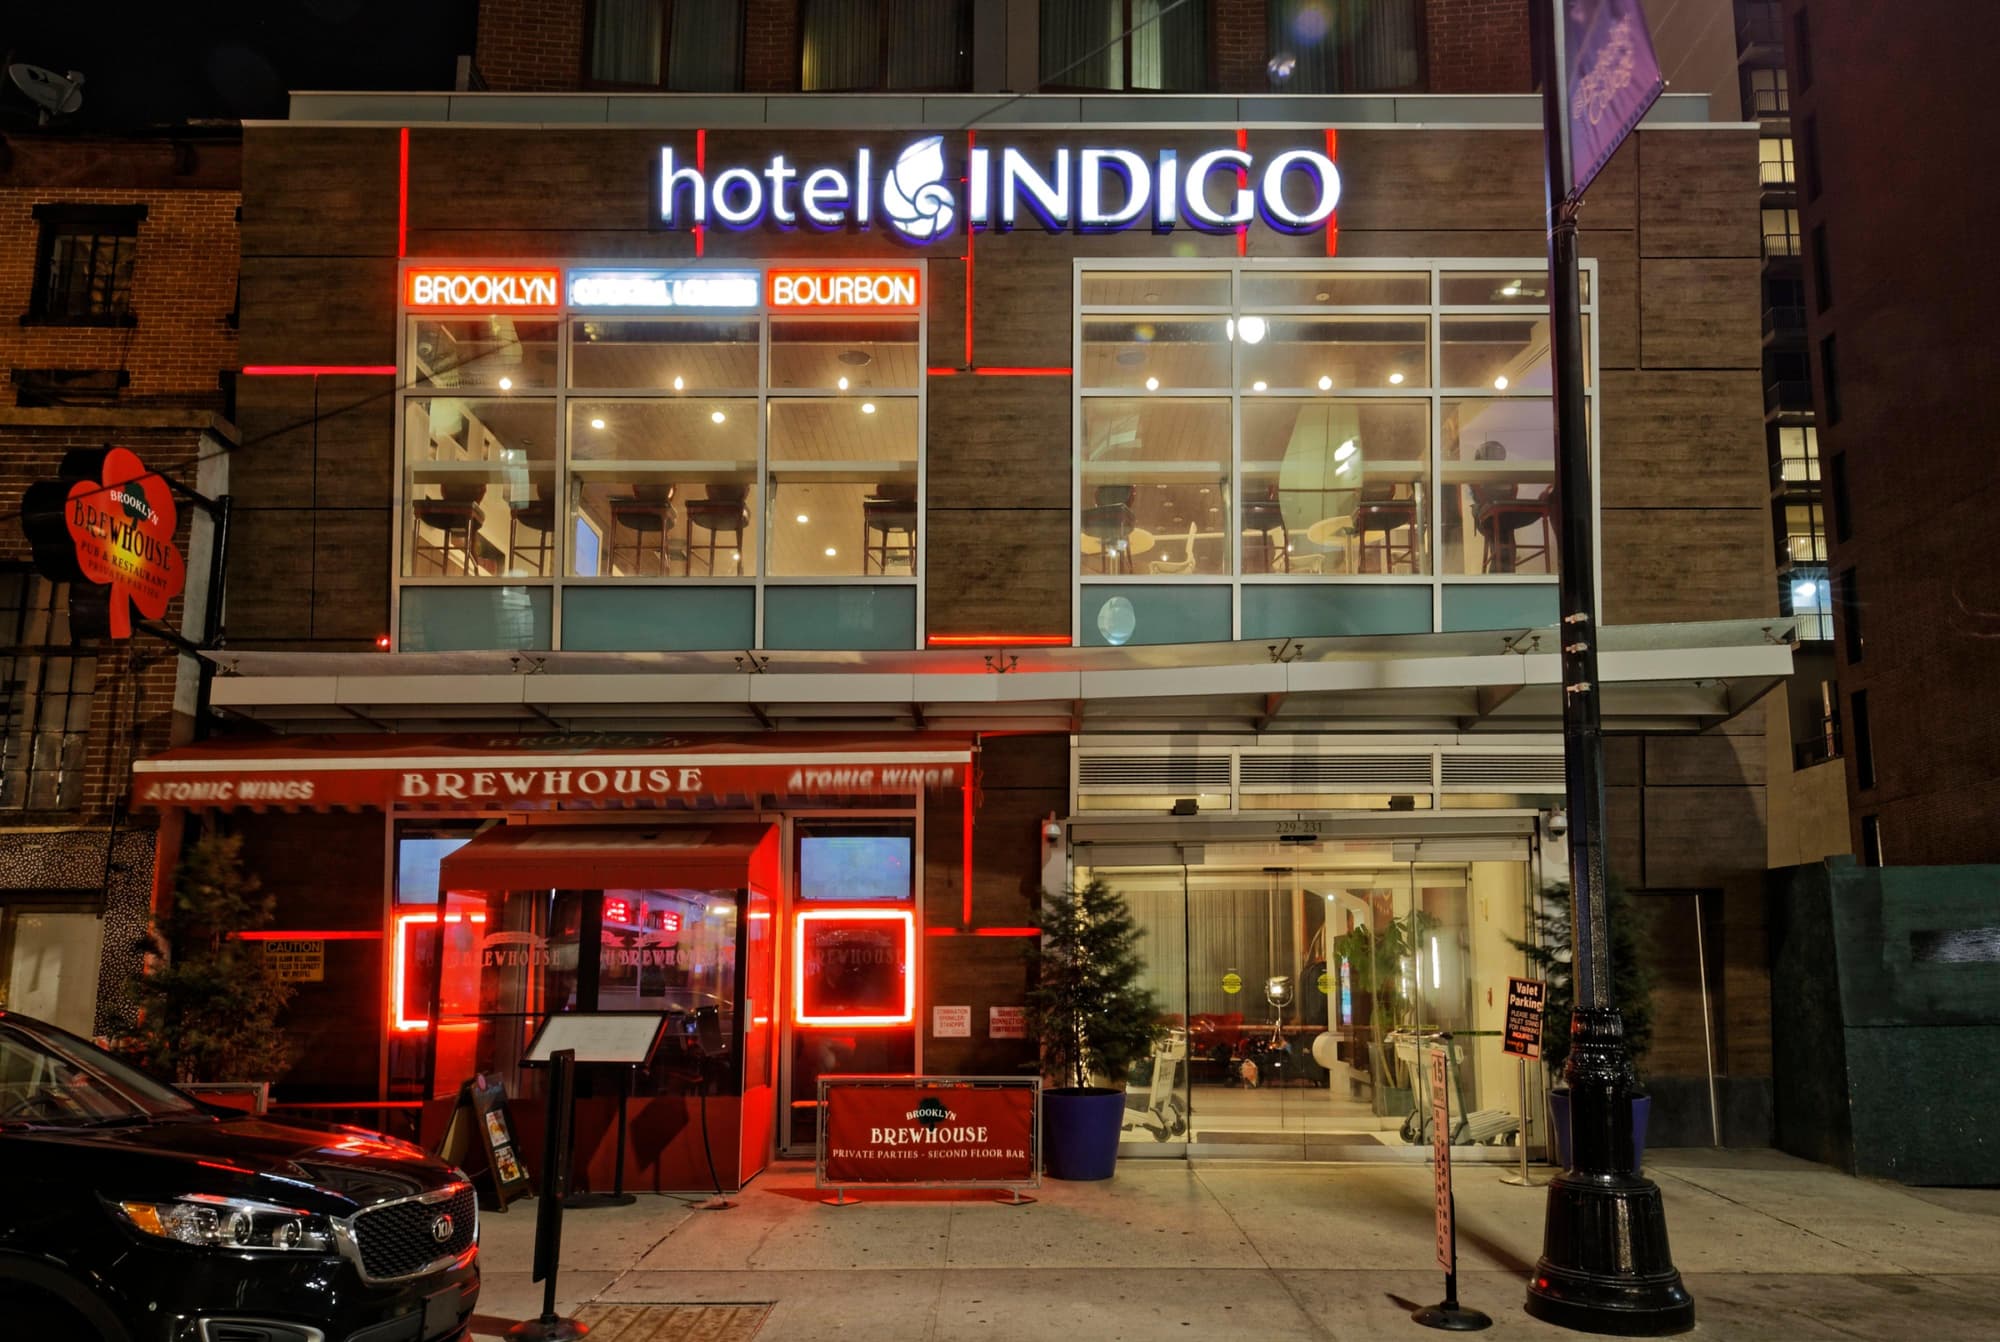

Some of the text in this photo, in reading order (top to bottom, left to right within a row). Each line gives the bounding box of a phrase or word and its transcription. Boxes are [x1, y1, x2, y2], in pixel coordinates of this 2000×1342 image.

[661, 146, 1341, 225] hotel INDIGO
[414, 275, 557, 305] BROOKLYN
[774, 275, 915, 305] BOURBON
[110, 489, 159, 526] BROOKLYN
[73, 500, 171, 571] BREWHOUSE
[81, 541, 99, 557] PUB
[112, 554, 168, 589] RESTAURANT
[401, 768, 703, 799] BREWHOUSE
[788, 769, 874, 790] ATOMIC
[145, 782, 314, 800] ATOMIC WINGS
[1275, 822, 1322, 833] 229-231
[267, 943, 320, 953] CAUTION
[1516, 982, 1538, 997] Valet
[1510, 994, 1543, 1012] Parking
[1433, 1058, 1443, 1082] 15
[906, 1108, 957, 1122] BROOKLYN
[870, 1126, 988, 1146] BREWHOUSE
[832, 1148, 875, 1159] PRIVATE
[877, 1150, 919, 1159] PARTIES
[928, 1149, 968, 1159] SECOND
[970, 1148, 1003, 1158] FLOOR
[1006, 1149, 1025, 1159] BAR
